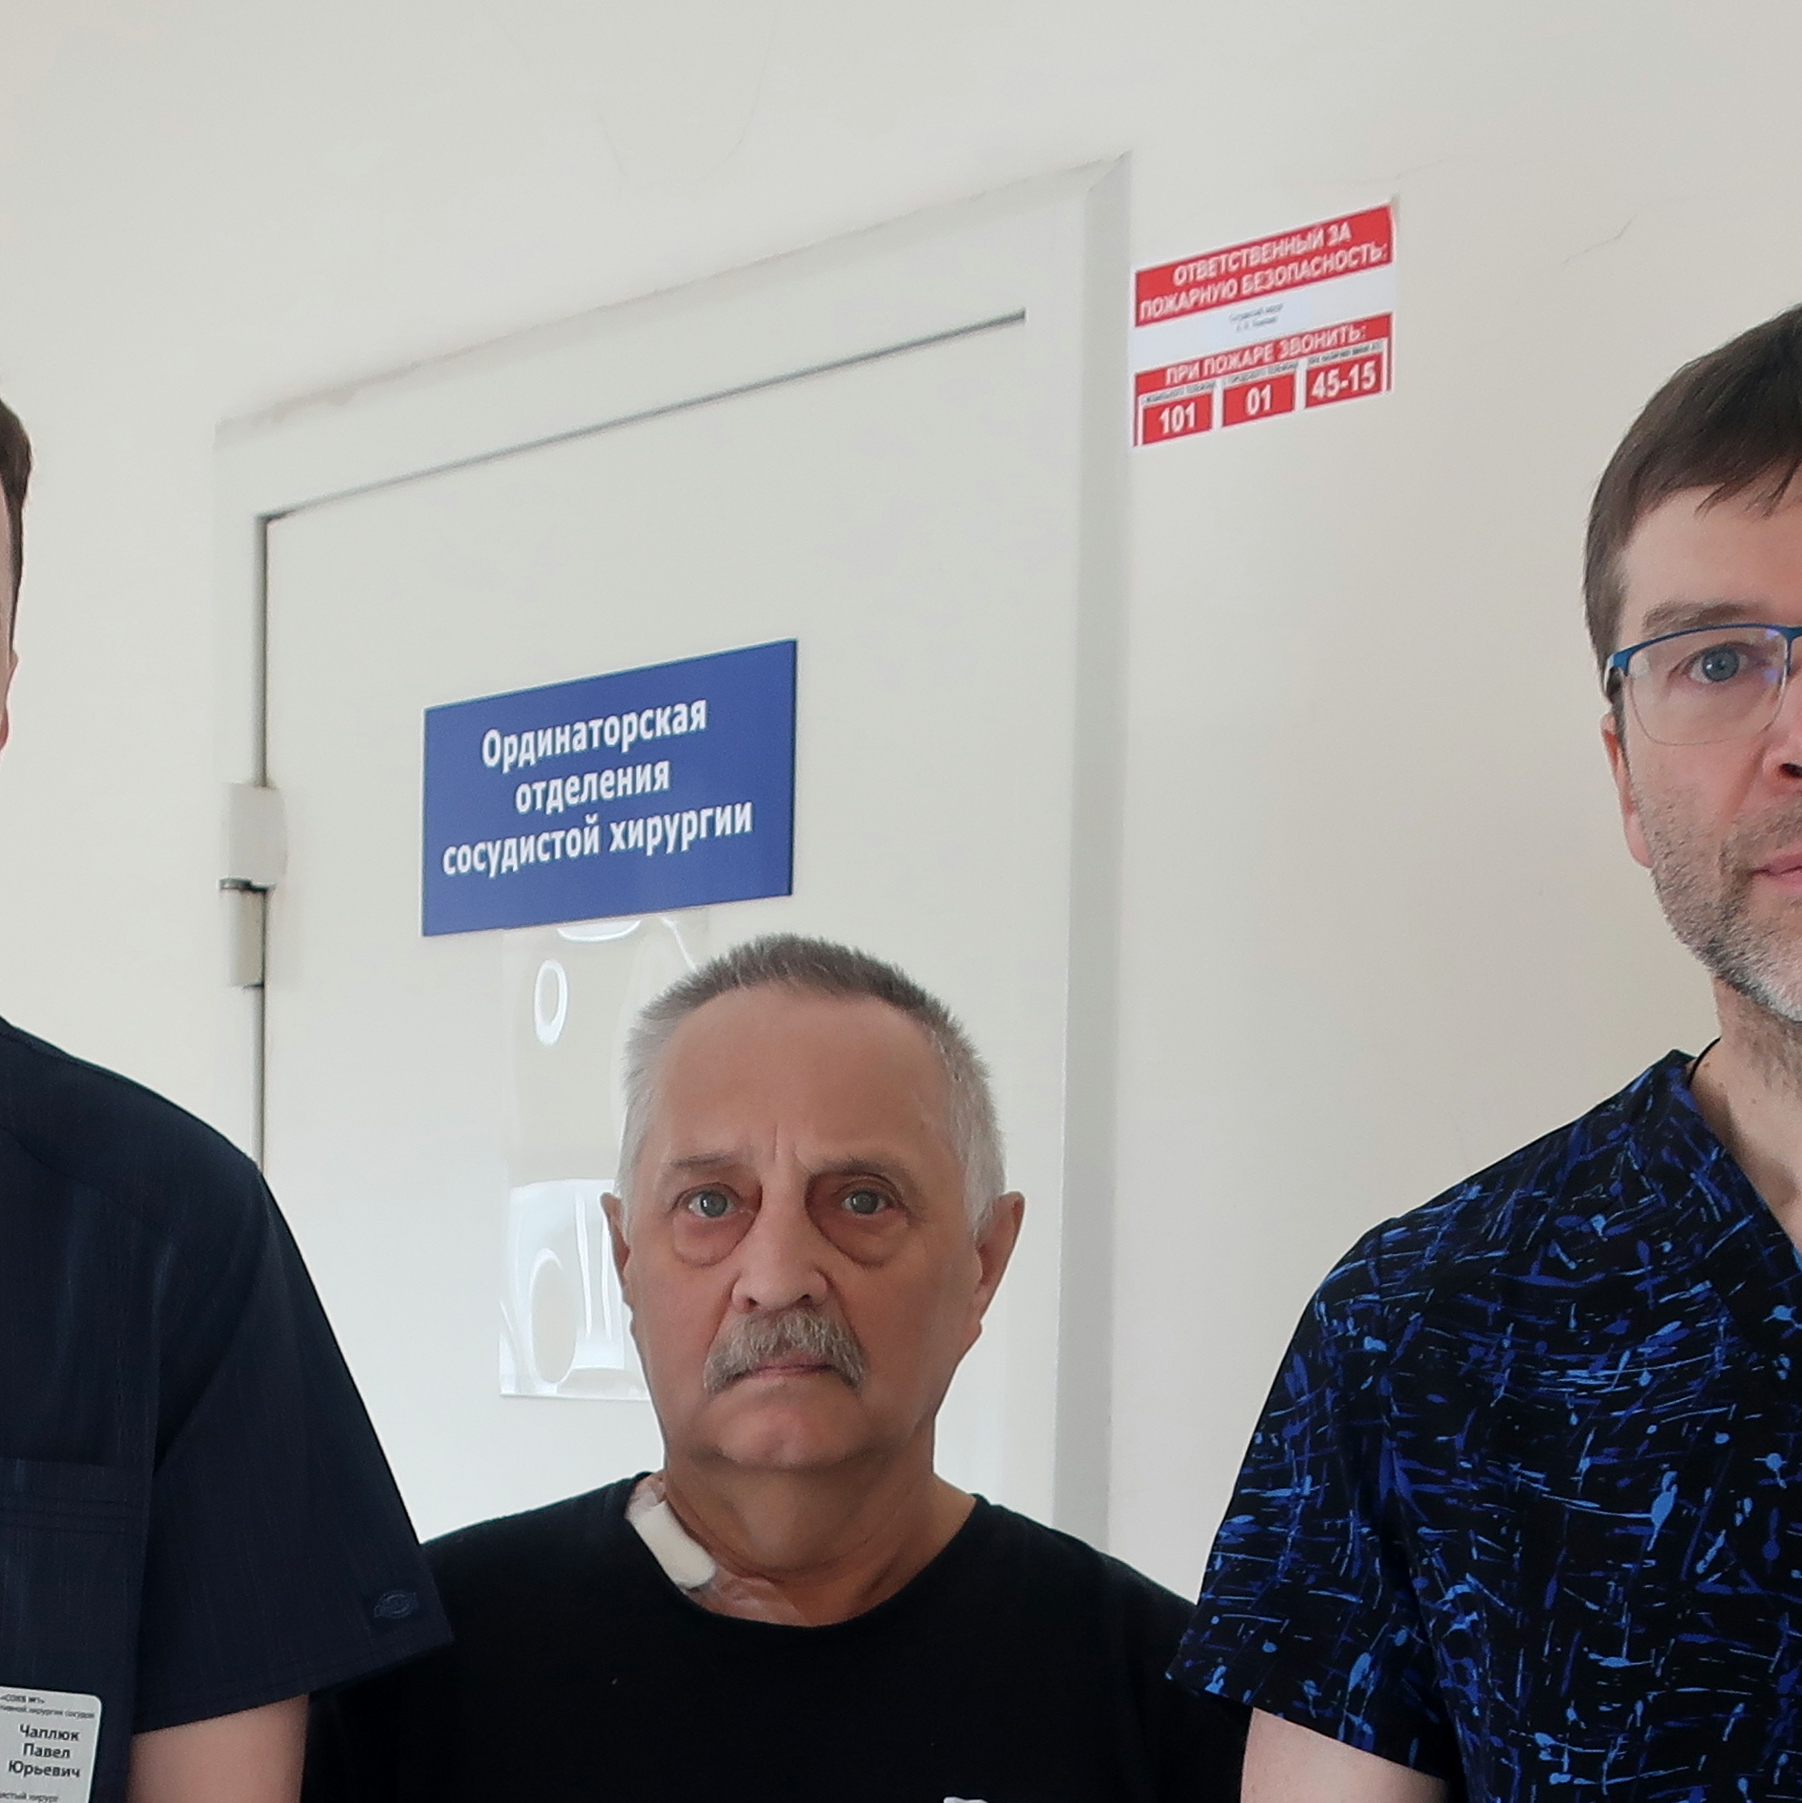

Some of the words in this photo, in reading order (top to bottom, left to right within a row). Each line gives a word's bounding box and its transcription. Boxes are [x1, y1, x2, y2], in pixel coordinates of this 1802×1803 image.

[1172, 225, 1325, 286] ОТВЕТСТВЕННЫЙ
[1327, 222, 1352, 247] ЗА
[1139, 278, 1238, 321] ПОЖАРНУЮ
[1241, 243, 1387, 296] БЕЗОПАСНОСТЬ:
[1165, 357, 1199, 386] ПРИ
[1203, 343, 1275, 376] ПОЖАРЕ
[1278, 323, 1367, 360] ЗВОНИТЬ:
[1246, 385, 1273, 415] 01
[1311, 360, 1377, 399] 45-15
[1159, 402, 1197, 435] 101
[482, 699, 708, 774] Ординаторская
[514, 760, 671, 814] отделения
[442, 814, 600, 878] сосудистой
[608, 801, 753, 856] хирургии
[19, 1723, 80, 1741] Чаплюк
[23, 1743, 71, 1759] Павел
[8, 1760, 81, 1778] Юрьевич
